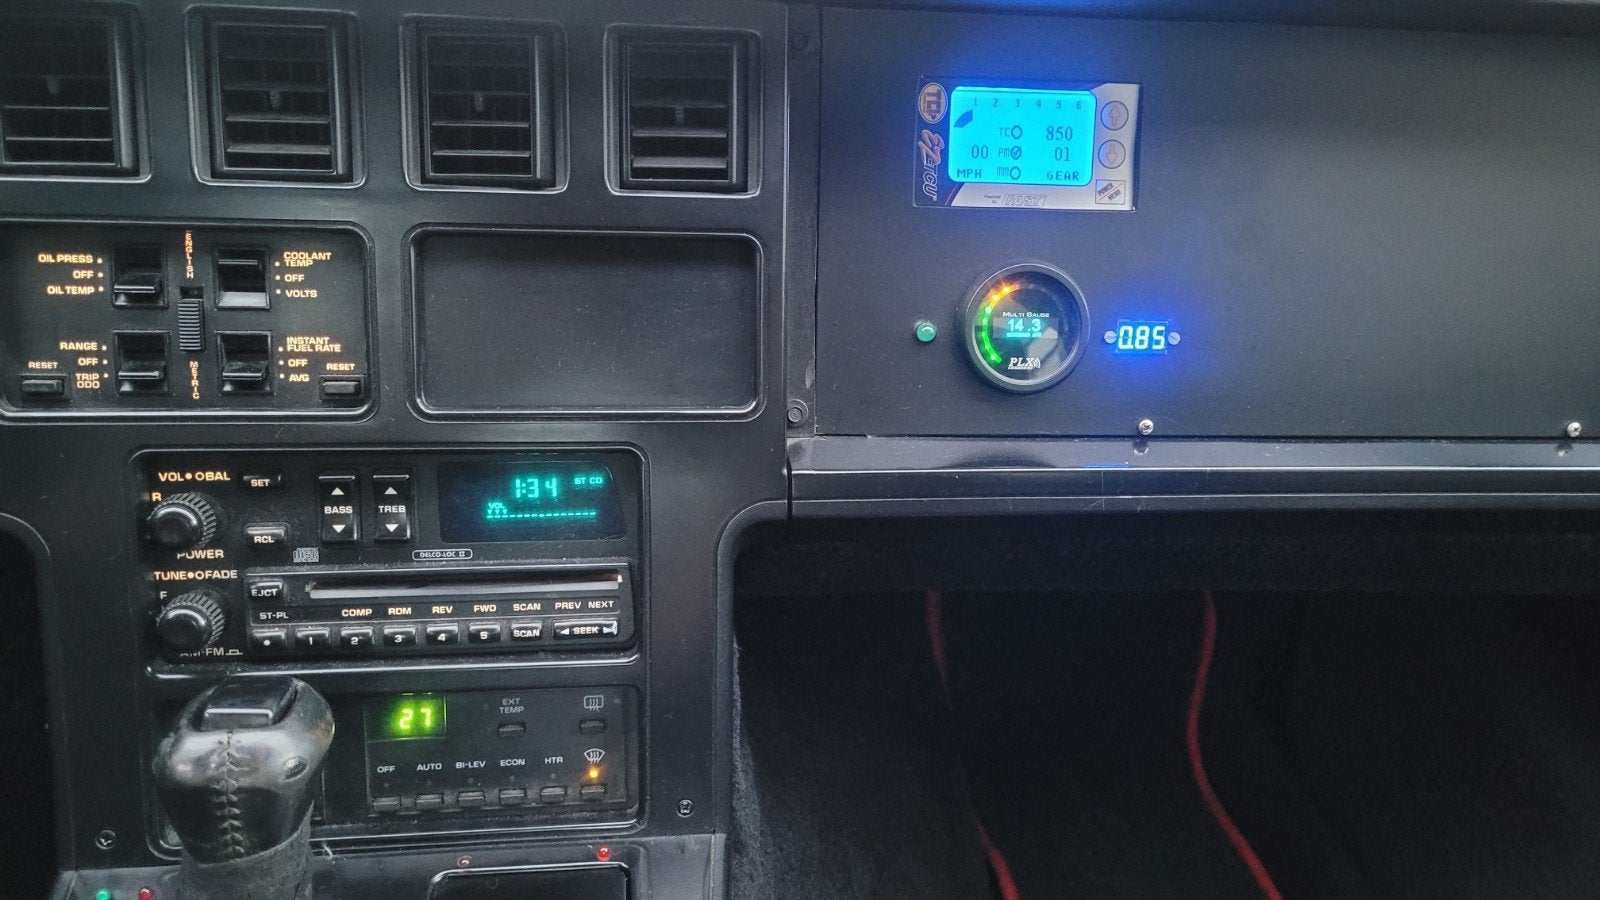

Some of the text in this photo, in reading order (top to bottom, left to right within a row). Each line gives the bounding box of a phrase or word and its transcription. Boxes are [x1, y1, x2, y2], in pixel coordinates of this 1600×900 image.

[973, 98, 1082, 109] 1 2 3 4 5 6
[1046, 126, 1073, 141] 850
[971, 145, 989, 159] 00
[1054, 146, 1071, 162] 01
[956, 168, 982, 179] MPH
[1046, 170, 1080, 181] GEAR
[38, 254, 94, 264] OIL PRESS
[185, 233, 194, 279] ENGLISH
[284, 252, 332, 260] COOLANT
[284, 259, 313, 267] TEMP
[73, 271, 94, 279] OFF
[284, 274, 305, 282] OFF
[47, 286, 95, 295] OIL TEMP
[285, 290, 318, 298] VOLTS
[287, 337, 329, 345] INSTANT
[60, 342, 98, 350] RANGE
[287, 344, 341, 352] FUEL RATE
[28, 362, 58, 370] RESET
[78, 358, 98, 366] OFF
[288, 359, 308, 367] OFF
[1008, 357, 1035, 367] PLX
[326, 363, 355, 371] RESET
[75, 373, 99, 382] TRIP
[190, 361, 200, 399] METRIC
[289, 374, 310, 382] AVG
[77, 381, 100, 389] ODO
[251, 479, 270, 487] SET
[515, 478, 557, 498] 1:34
[152, 493, 162, 501] R
[324, 506, 353, 514] BASS
[378, 505, 406, 513] TREB
[254, 536, 275, 544] RCL
[160, 591, 168, 600] F
[251, 588, 278, 597] EJCT
[473, 604, 497, 613] FWD
[513, 603, 541, 611] SCAN
[555, 600, 614, 610] PREV NEXT
[341, 609, 373, 617] COMP
[388, 607, 412, 615] RDM
[432, 606, 453, 614] REV
[259, 612, 289, 620] ST-PL
[513, 629, 540, 638] SCAN
[573, 626, 599, 634] SEEK
[394, 634, 402, 643] 3
[437, 633, 446, 642] 4
[480, 631, 488, 640] 5
[308, 636, 313, 645] 1
[351, 637, 359, 645] 2
[502, 698, 520, 706] EXT
[499, 706, 524, 714] TEMP
[399, 708, 432, 729] 27
[455, 760, 486, 769] BI-LEV
[500, 758, 525, 767] ECON
[544, 756, 563, 765] HTR
[377, 765, 396, 774] OFF
[416, 763, 442, 771] AUTO
